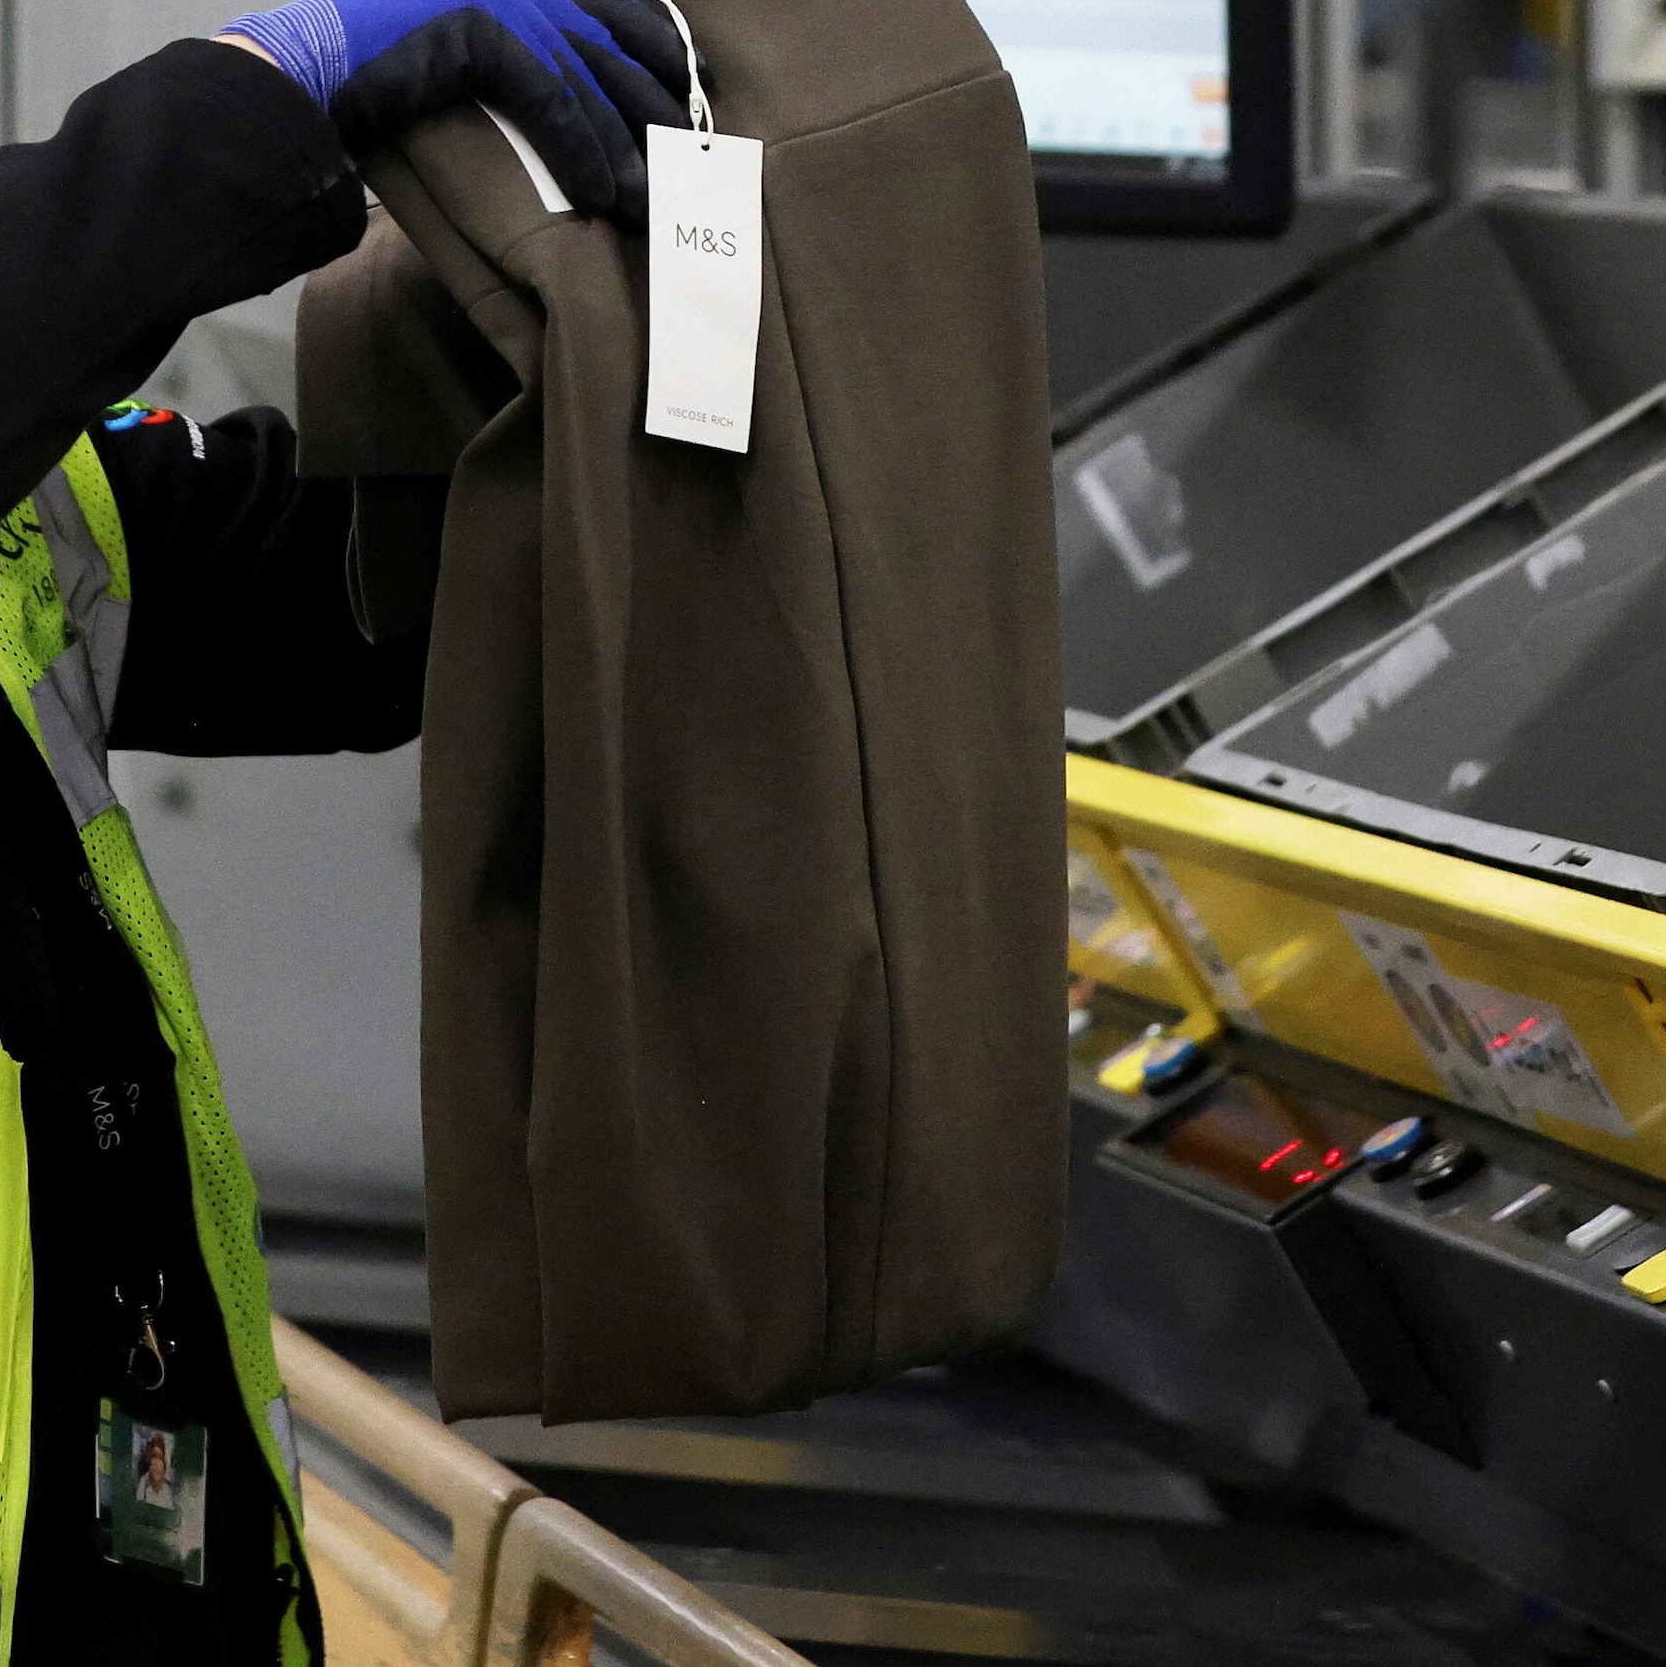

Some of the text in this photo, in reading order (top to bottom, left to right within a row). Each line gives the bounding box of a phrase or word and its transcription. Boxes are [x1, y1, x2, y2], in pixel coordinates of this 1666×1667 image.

[676, 222, 737, 257] M&S
[666, 406, 734, 427] VISCOSE RICH
[87, 1085, 121, 1150] M&S
